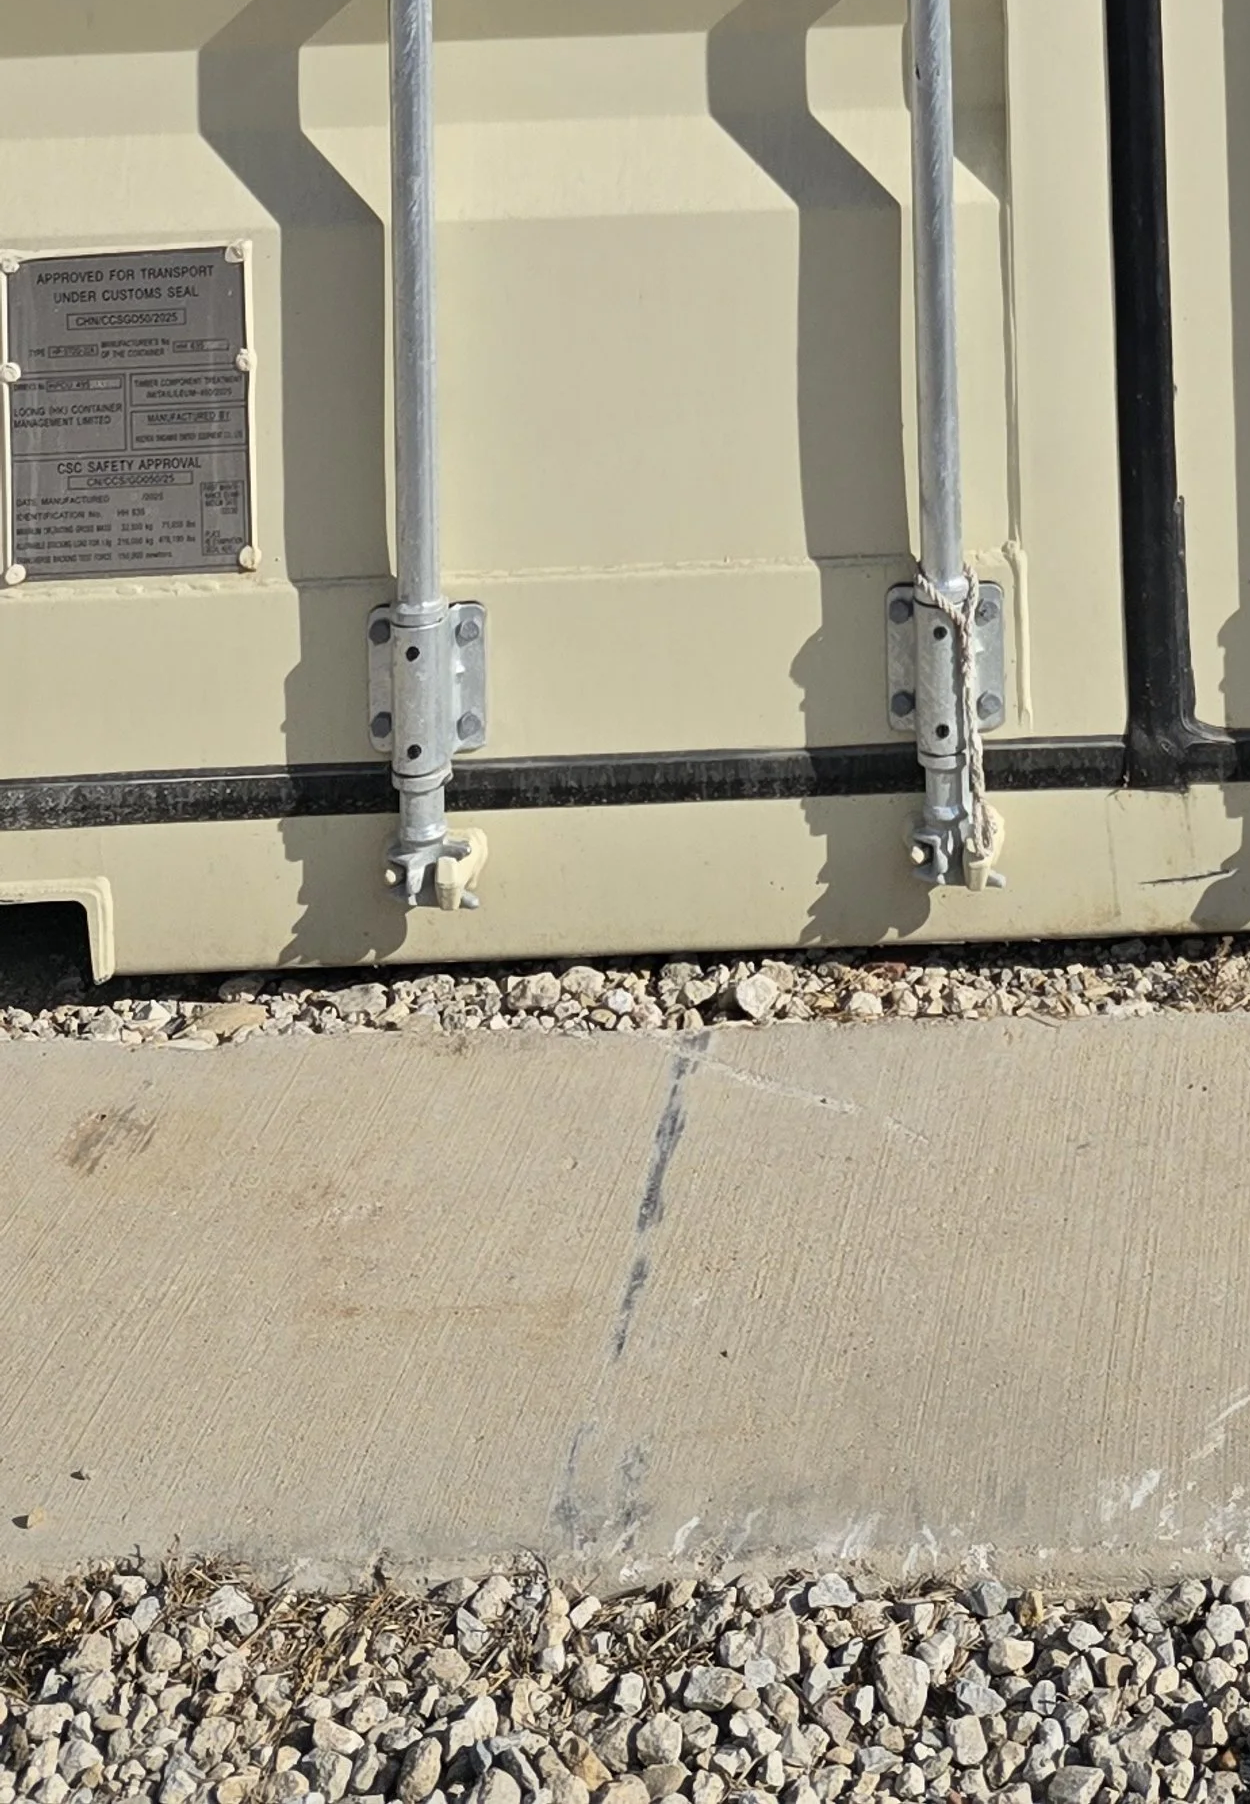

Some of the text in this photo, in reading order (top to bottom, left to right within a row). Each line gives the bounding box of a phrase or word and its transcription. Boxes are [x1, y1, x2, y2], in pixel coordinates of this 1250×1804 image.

[36, 264, 214, 285] APPROVED FOR TRANSPORT
[53, 285, 200, 304] UNDER CUSTOMS SEAL
[57, 456, 202, 474] CSC SAFETY APPROVAL
